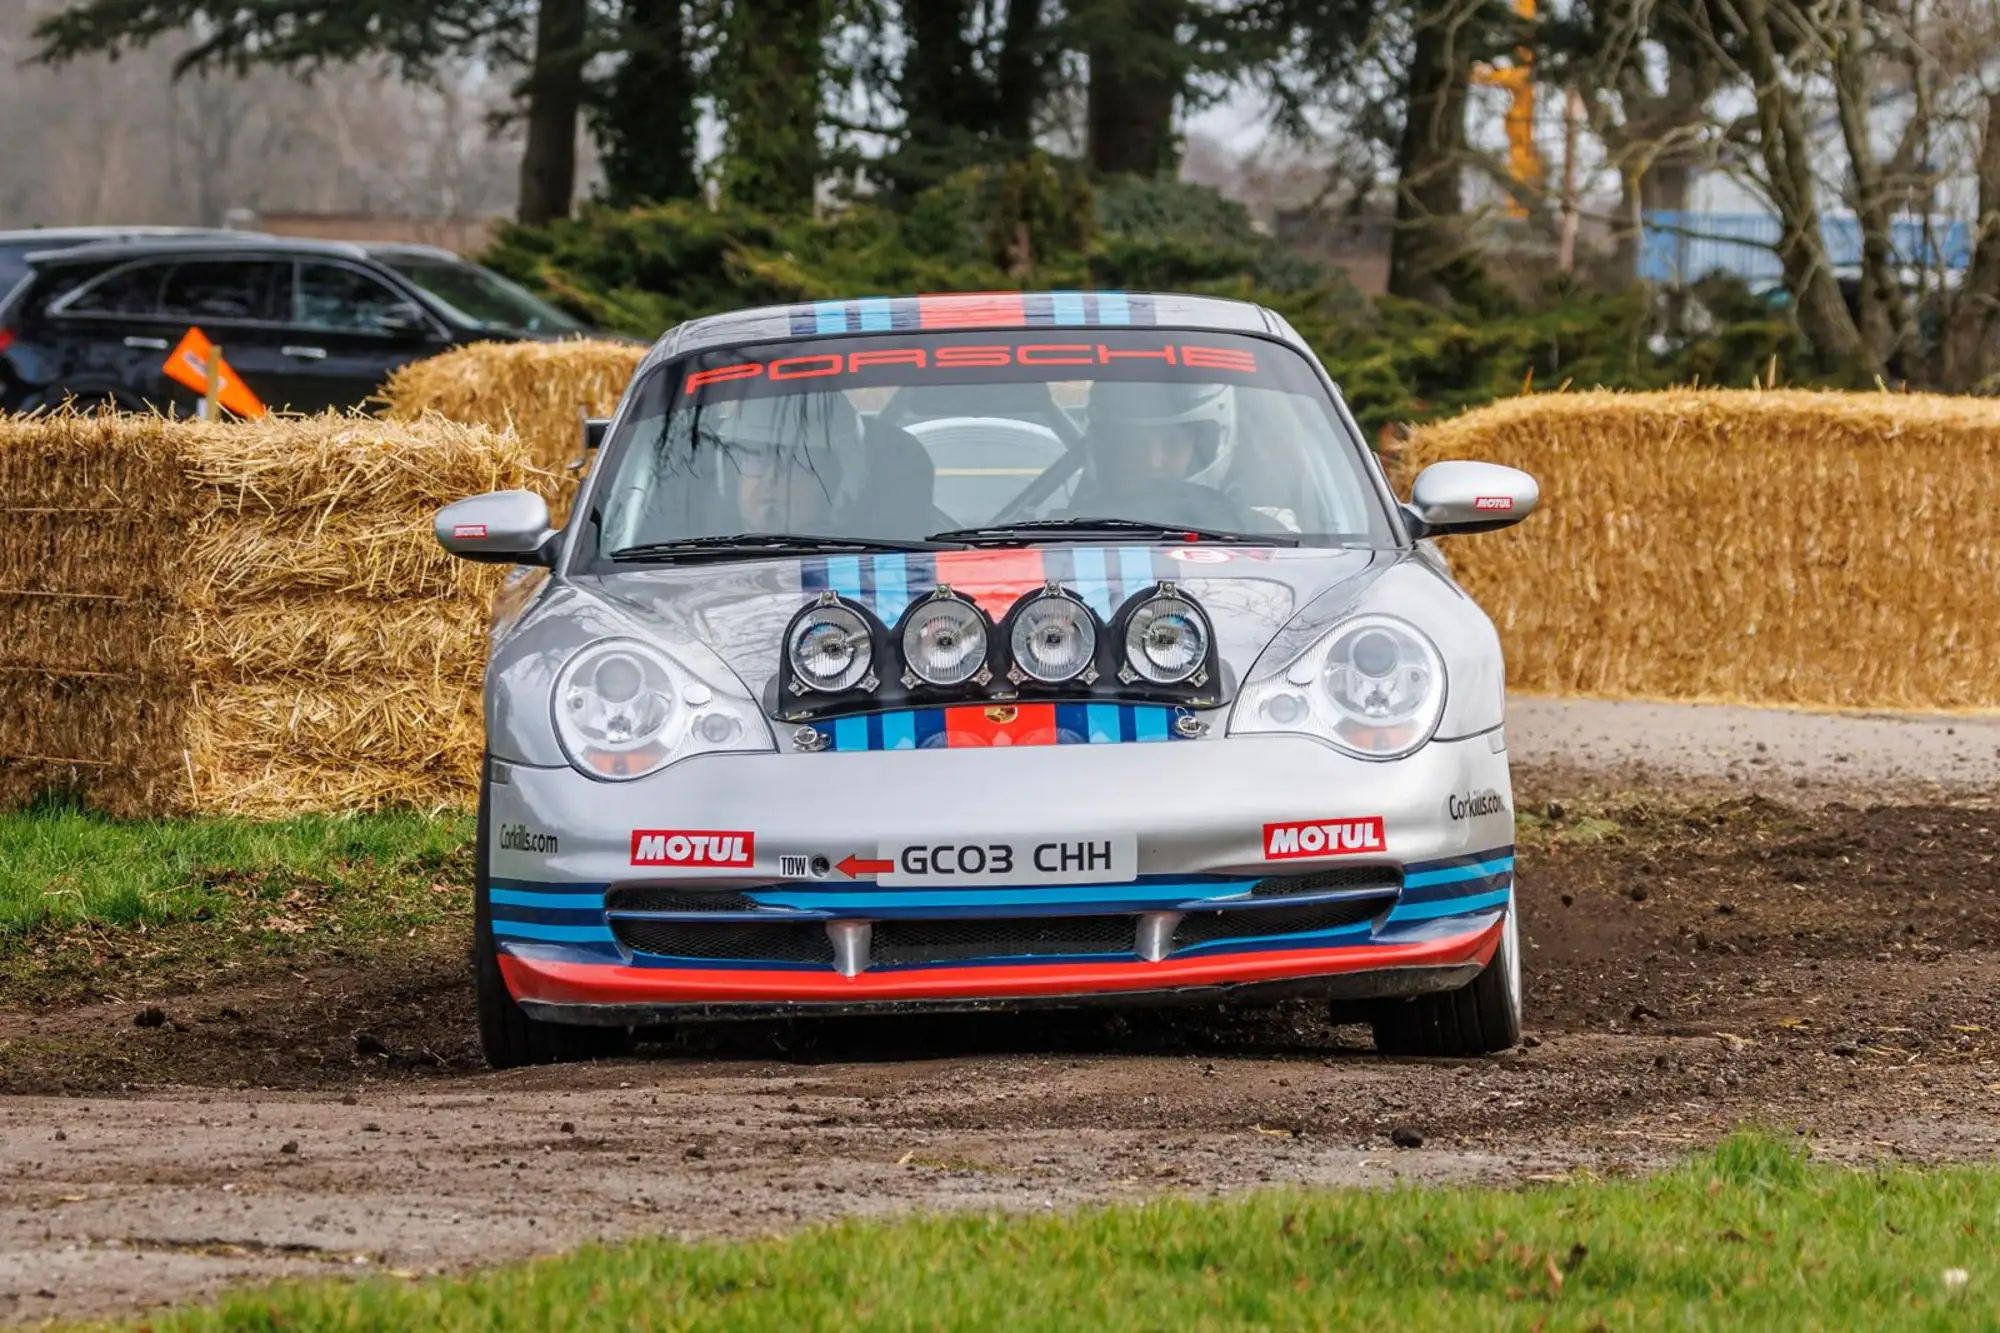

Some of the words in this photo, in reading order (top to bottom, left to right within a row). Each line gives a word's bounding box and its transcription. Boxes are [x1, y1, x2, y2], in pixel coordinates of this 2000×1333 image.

[685, 344, 1257, 395] PORSCHE
[635, 835, 749, 862] MOTUL
[1269, 822, 1380, 854] MOTUL
[781, 856, 806, 875] TOW
[1033, 841, 1111, 872] CHH
